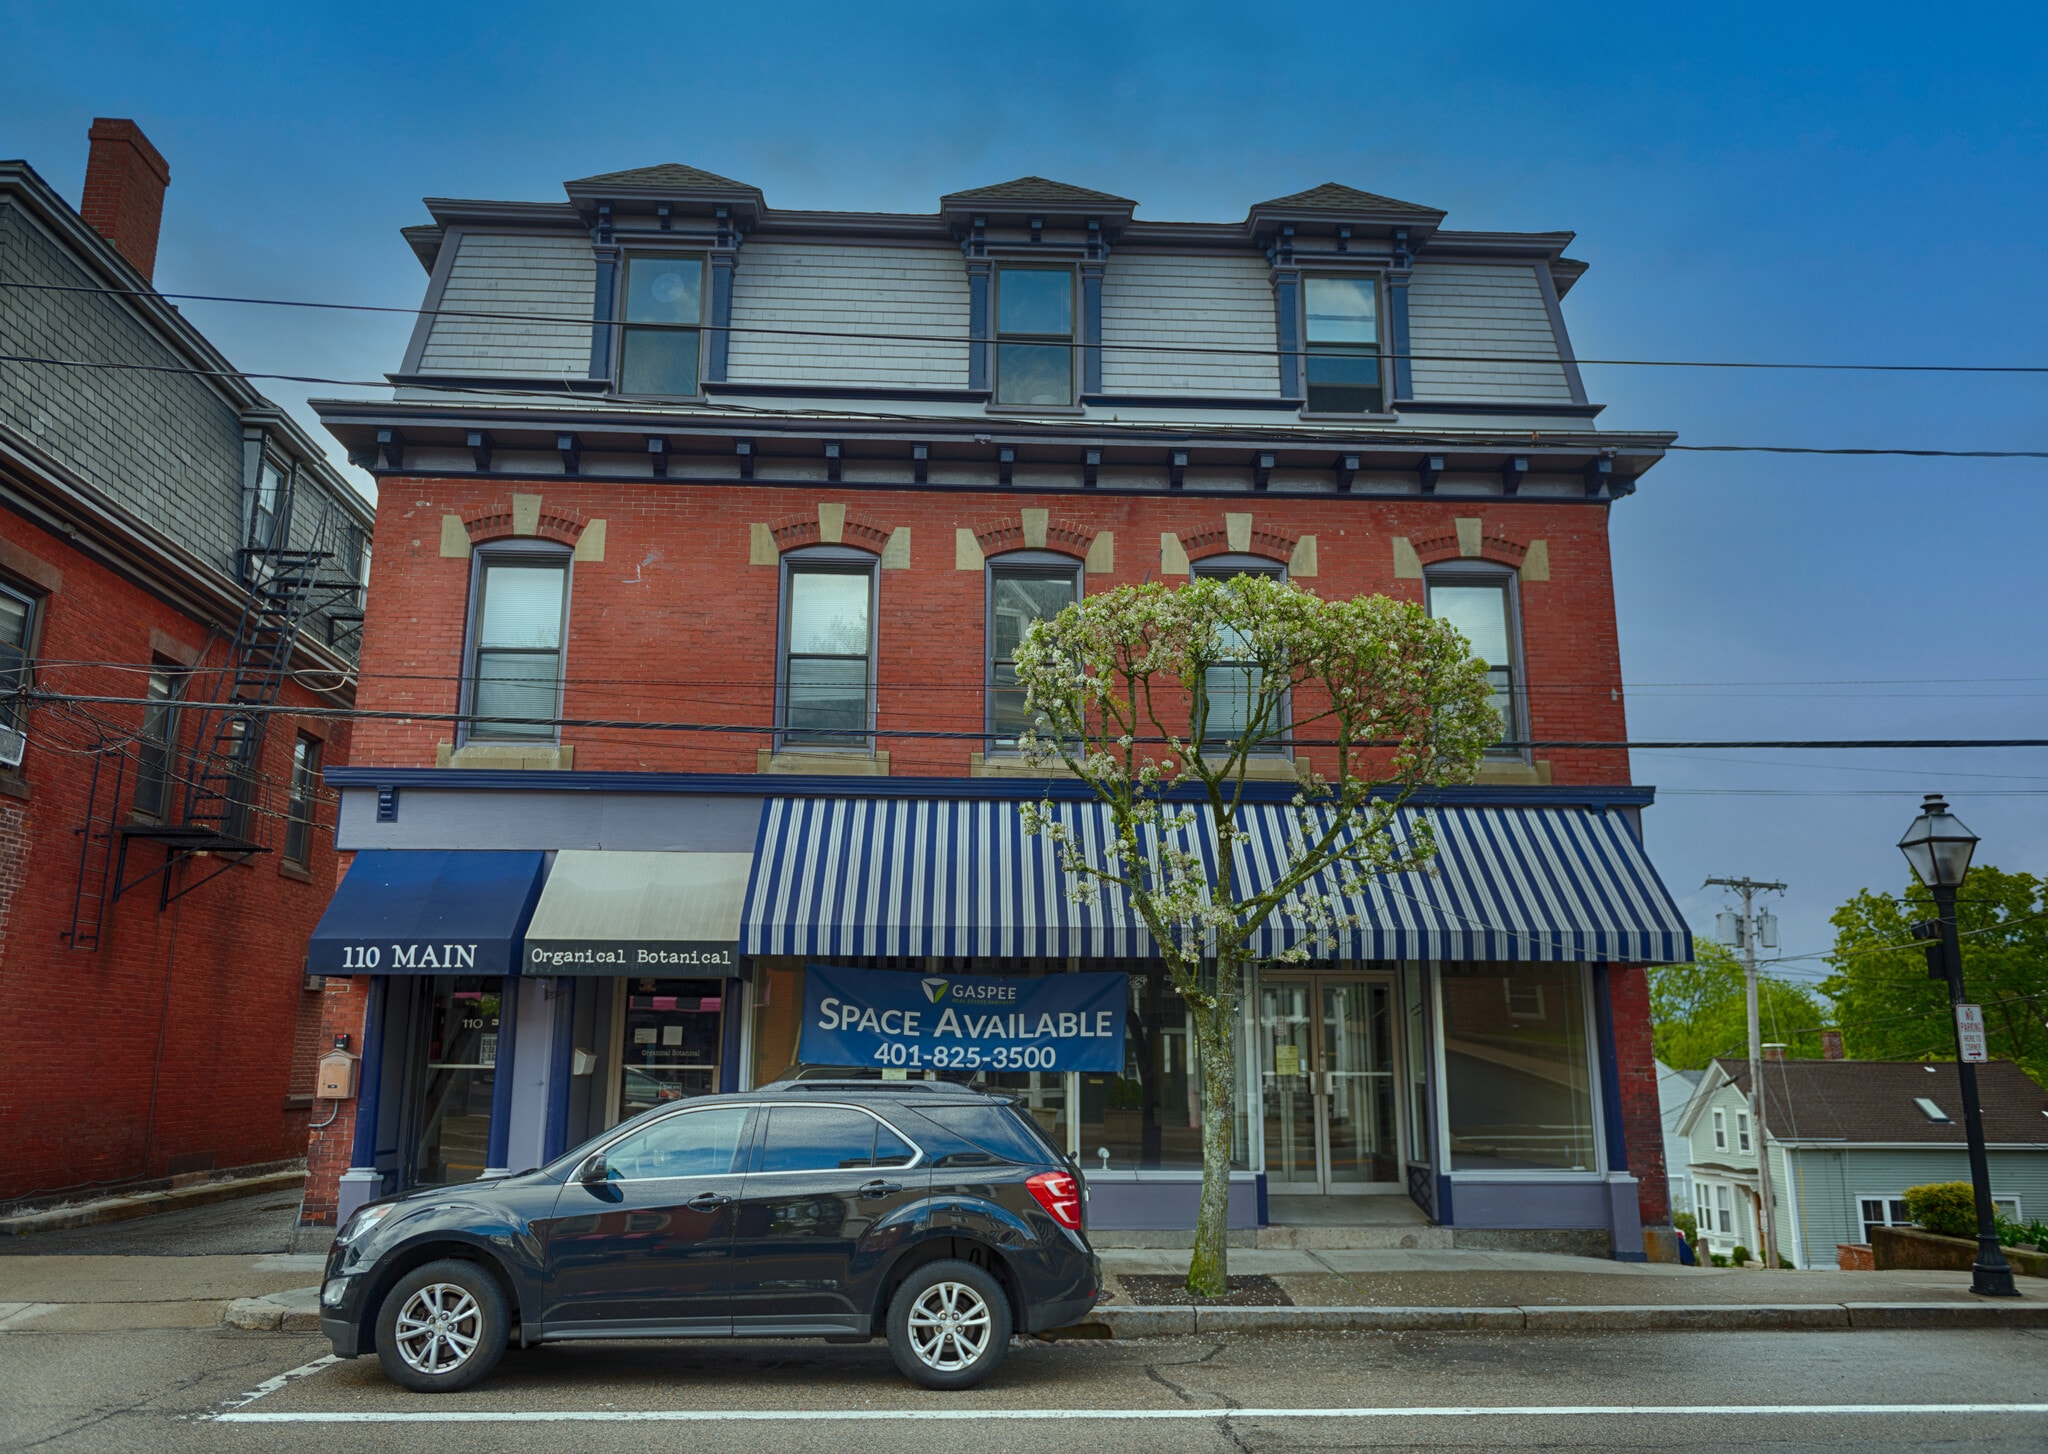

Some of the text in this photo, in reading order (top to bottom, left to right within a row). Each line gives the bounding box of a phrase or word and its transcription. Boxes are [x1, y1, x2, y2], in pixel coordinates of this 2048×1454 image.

[342, 944, 478, 968] 110 MAIN
[531, 948, 732, 966] Organical Botanical
[952, 984, 1017, 1000] GASPEE
[1965, 1010, 1974, 1021] NO
[462, 1018, 484, 1029] 110
[1960, 1022, 1982, 1032] PARKING
[641, 1049, 700, 1057] Organical Botanical
[873, 1042, 1056, 1069] 401-825-3500
